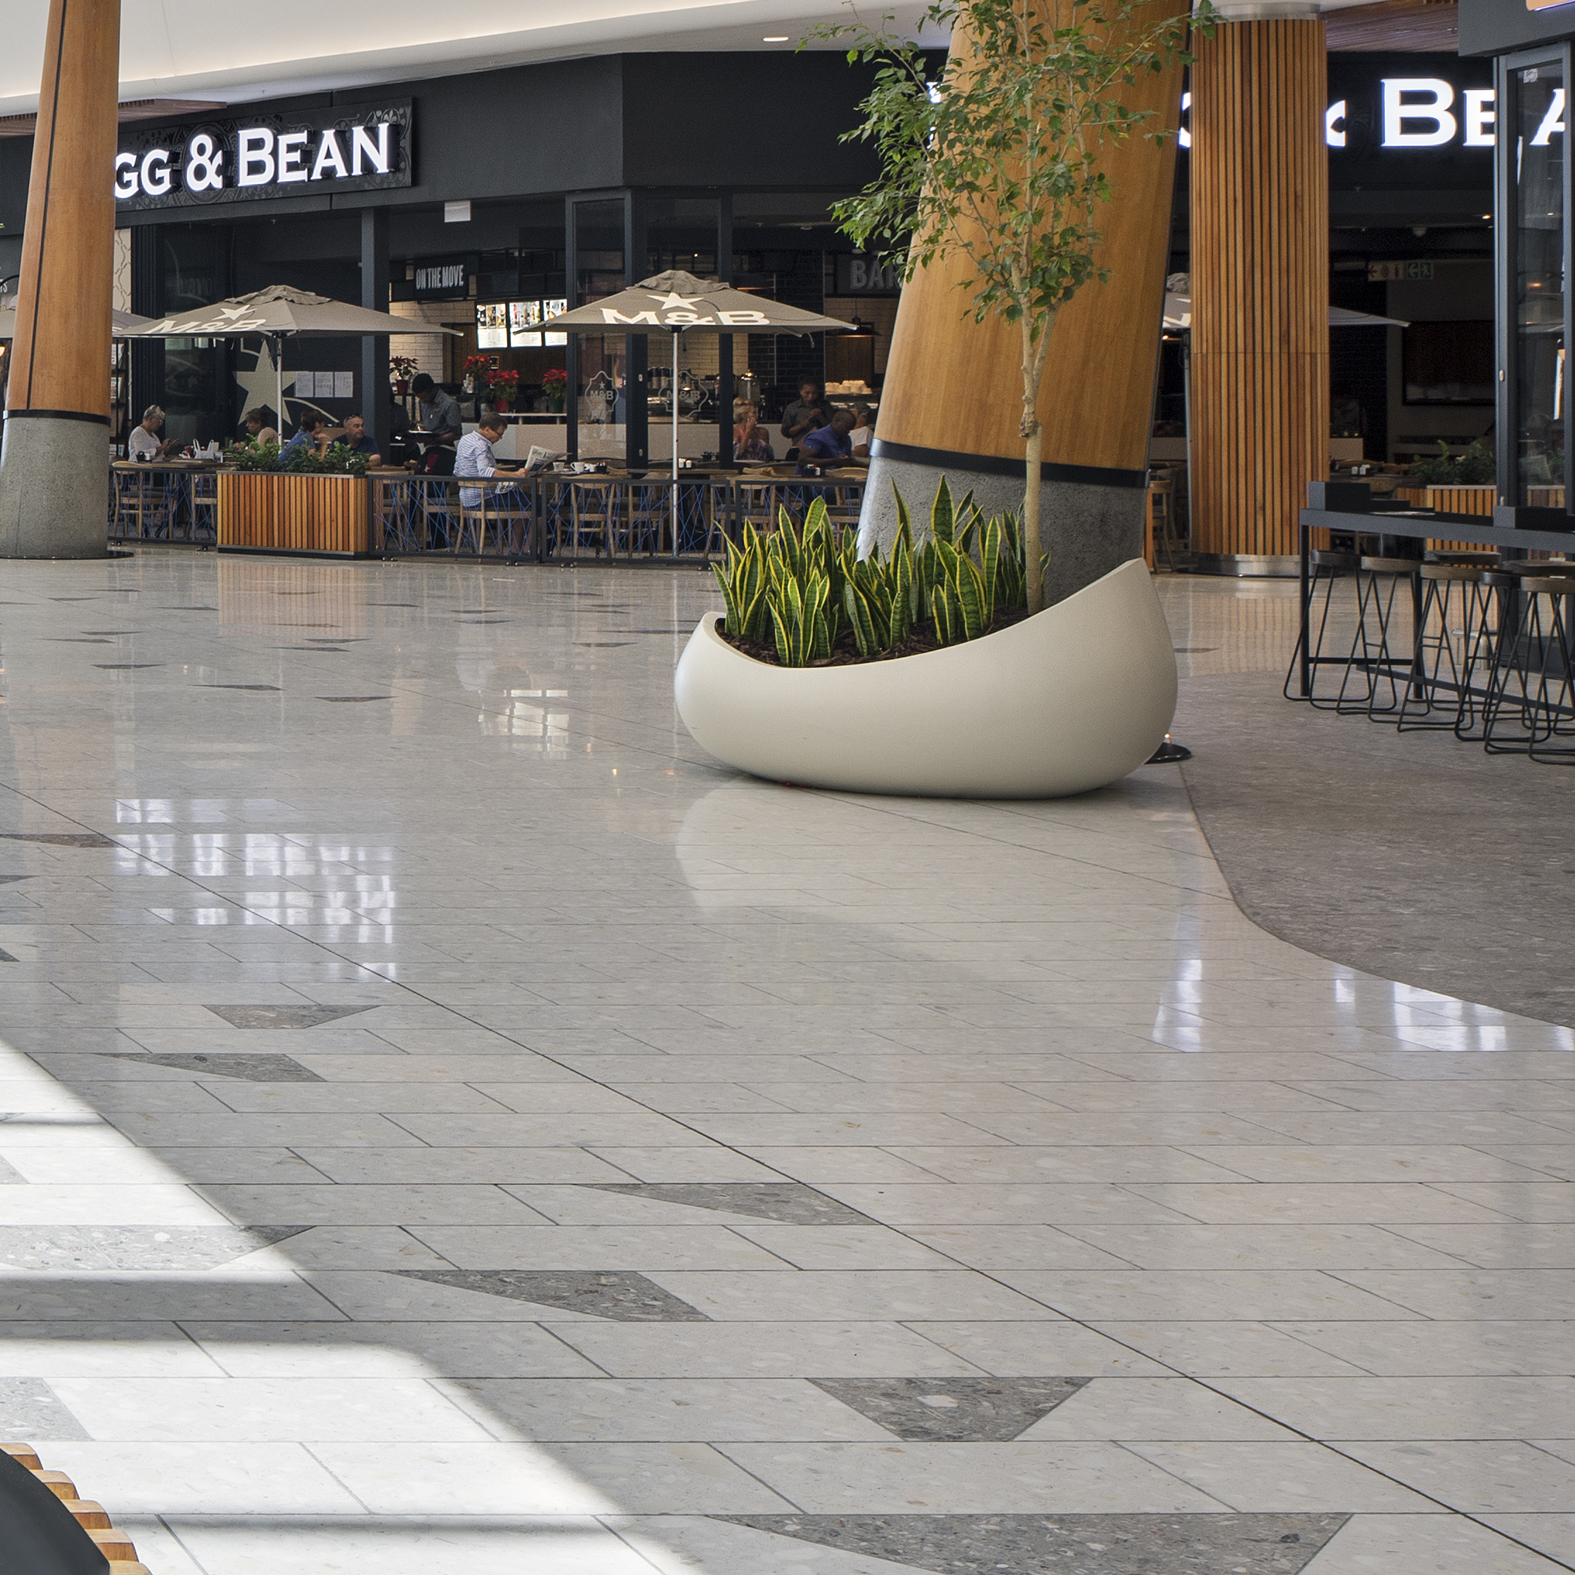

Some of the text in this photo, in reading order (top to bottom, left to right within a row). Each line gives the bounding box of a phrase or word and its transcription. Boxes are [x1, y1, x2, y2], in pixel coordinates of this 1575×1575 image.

[186, 133, 223, 191] &
[415, 265, 464, 290] ON THE MOVE
[600, 308, 770, 326] M&B
[145, 319, 266, 334] M&B
[591, 390, 614, 401] M&B
